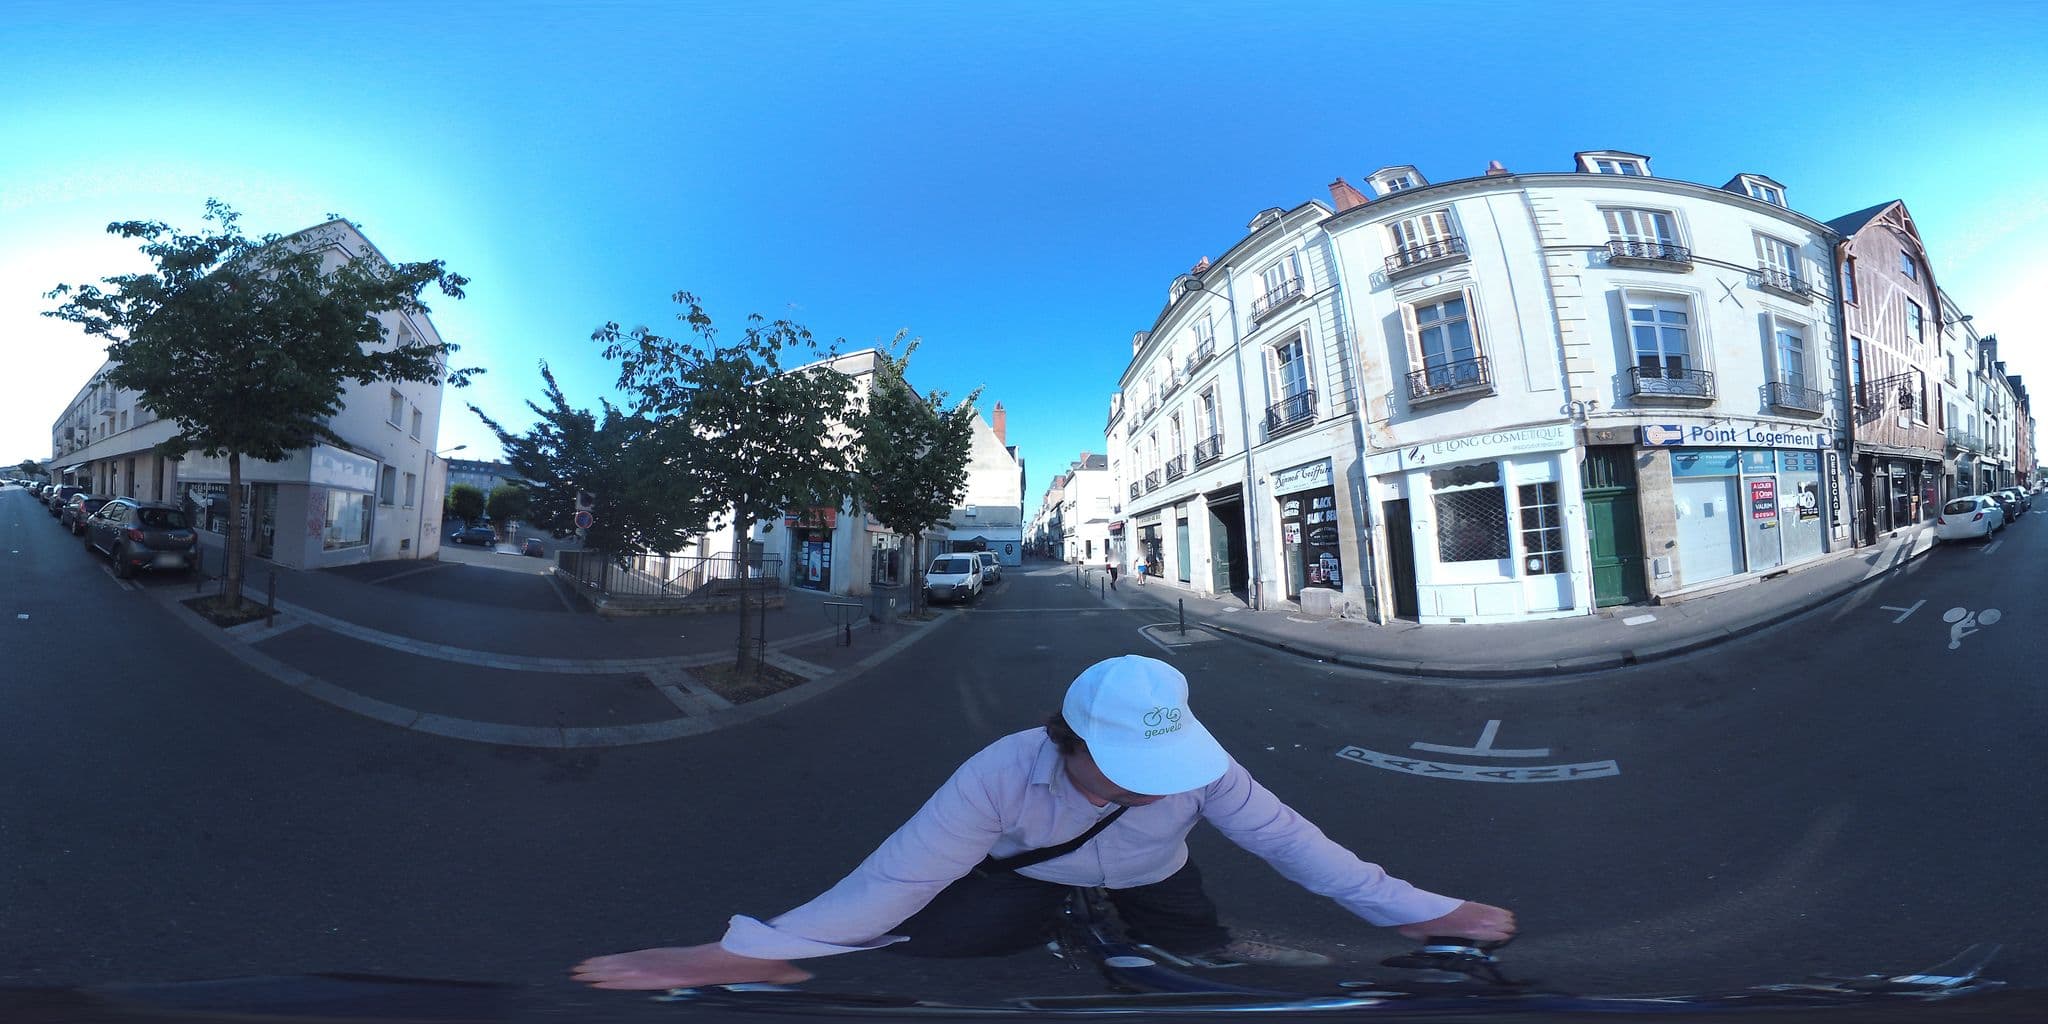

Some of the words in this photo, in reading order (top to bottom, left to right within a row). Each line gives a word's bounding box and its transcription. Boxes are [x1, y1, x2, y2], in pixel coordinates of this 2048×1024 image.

[1446, 436, 1479, 452] LONG
[1692, 426, 1737, 442] Point
[1747, 428, 1814, 446] Logement
[1313, 497, 1332, 510] BLACK
[1144, 722, 1182, 739] geovelo
[1342, 749, 1611, 780] PAYANT
